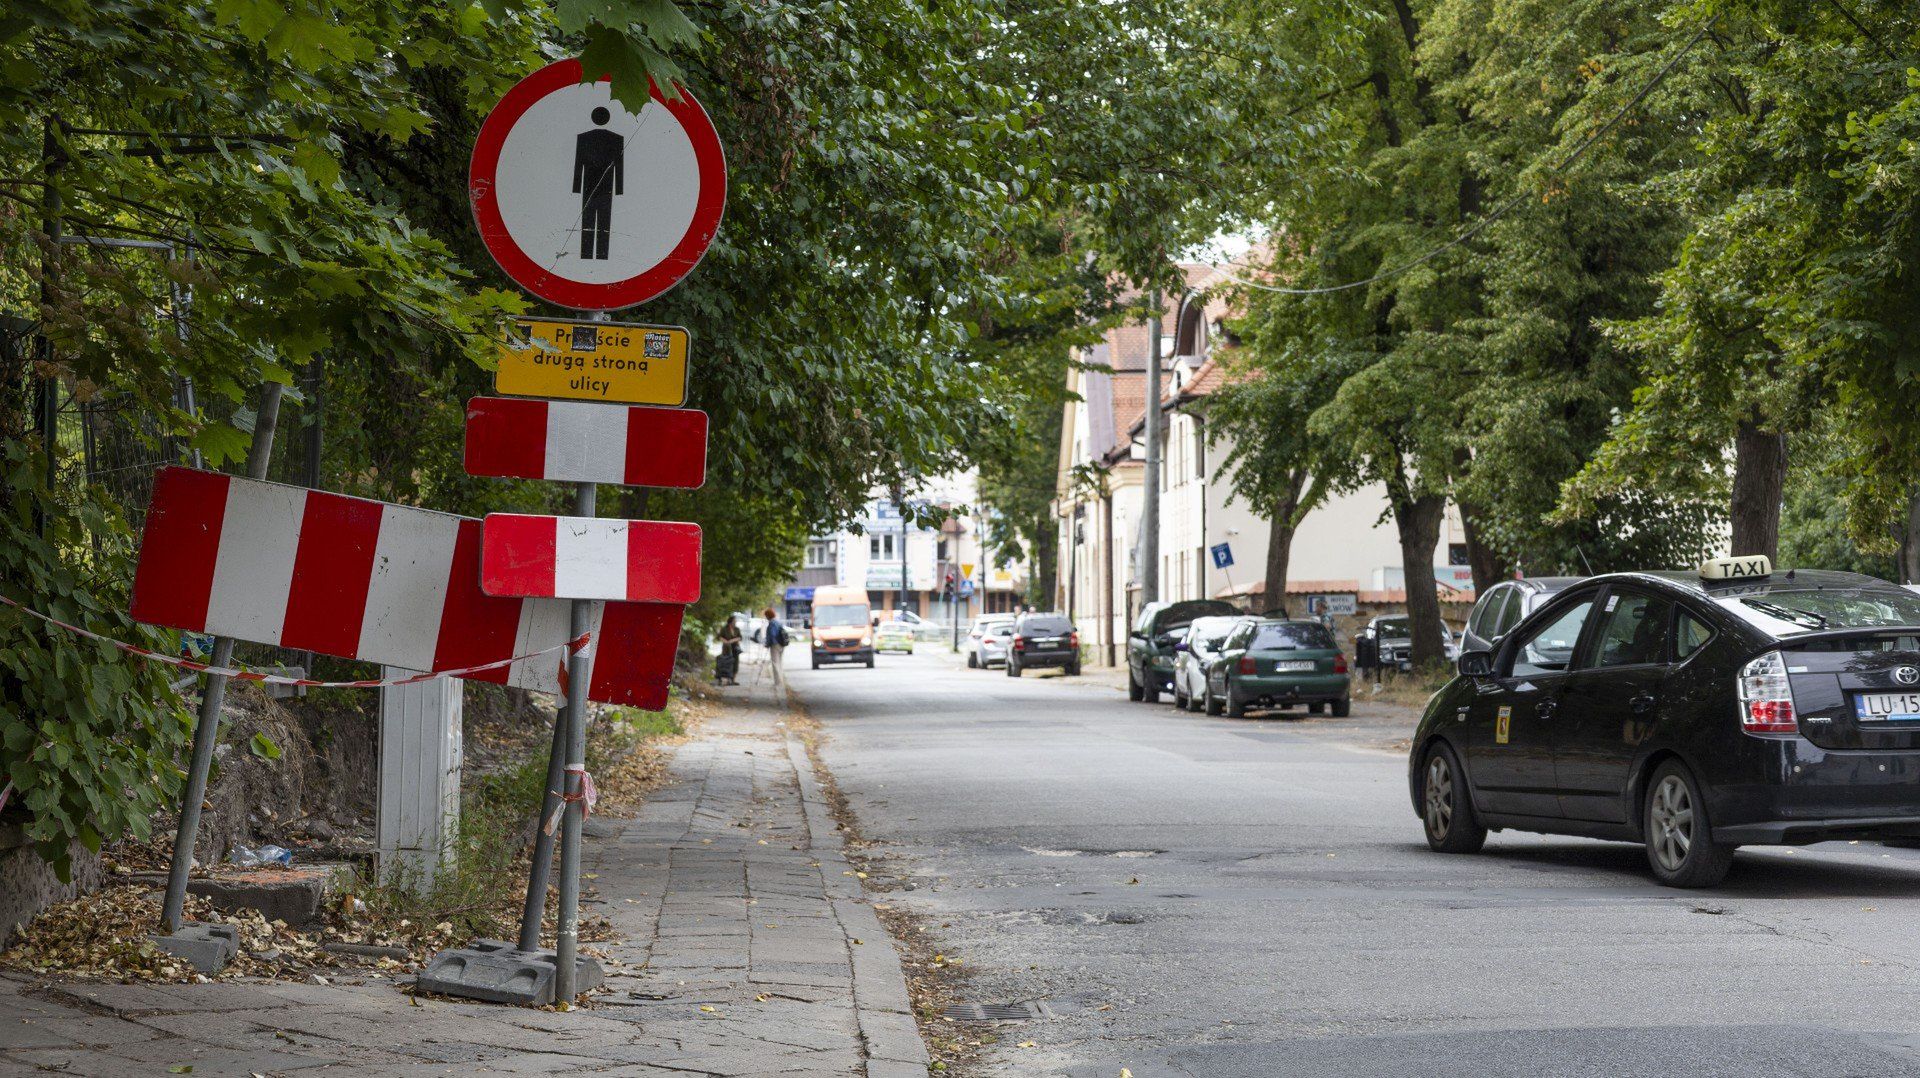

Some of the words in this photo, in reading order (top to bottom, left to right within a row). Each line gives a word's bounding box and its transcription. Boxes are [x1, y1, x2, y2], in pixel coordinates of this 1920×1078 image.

[556, 328, 630, 347] Prście
[534, 351, 585, 371] drugą
[593, 357, 648, 375] stroną
[570, 376, 610, 395] ulicy
[1218, 551, 1227, 564] P
[1720, 561, 1764, 577] TAXI
[1868, 696, 1892, 714] LU
[1900, 695, 1920, 713] 15
